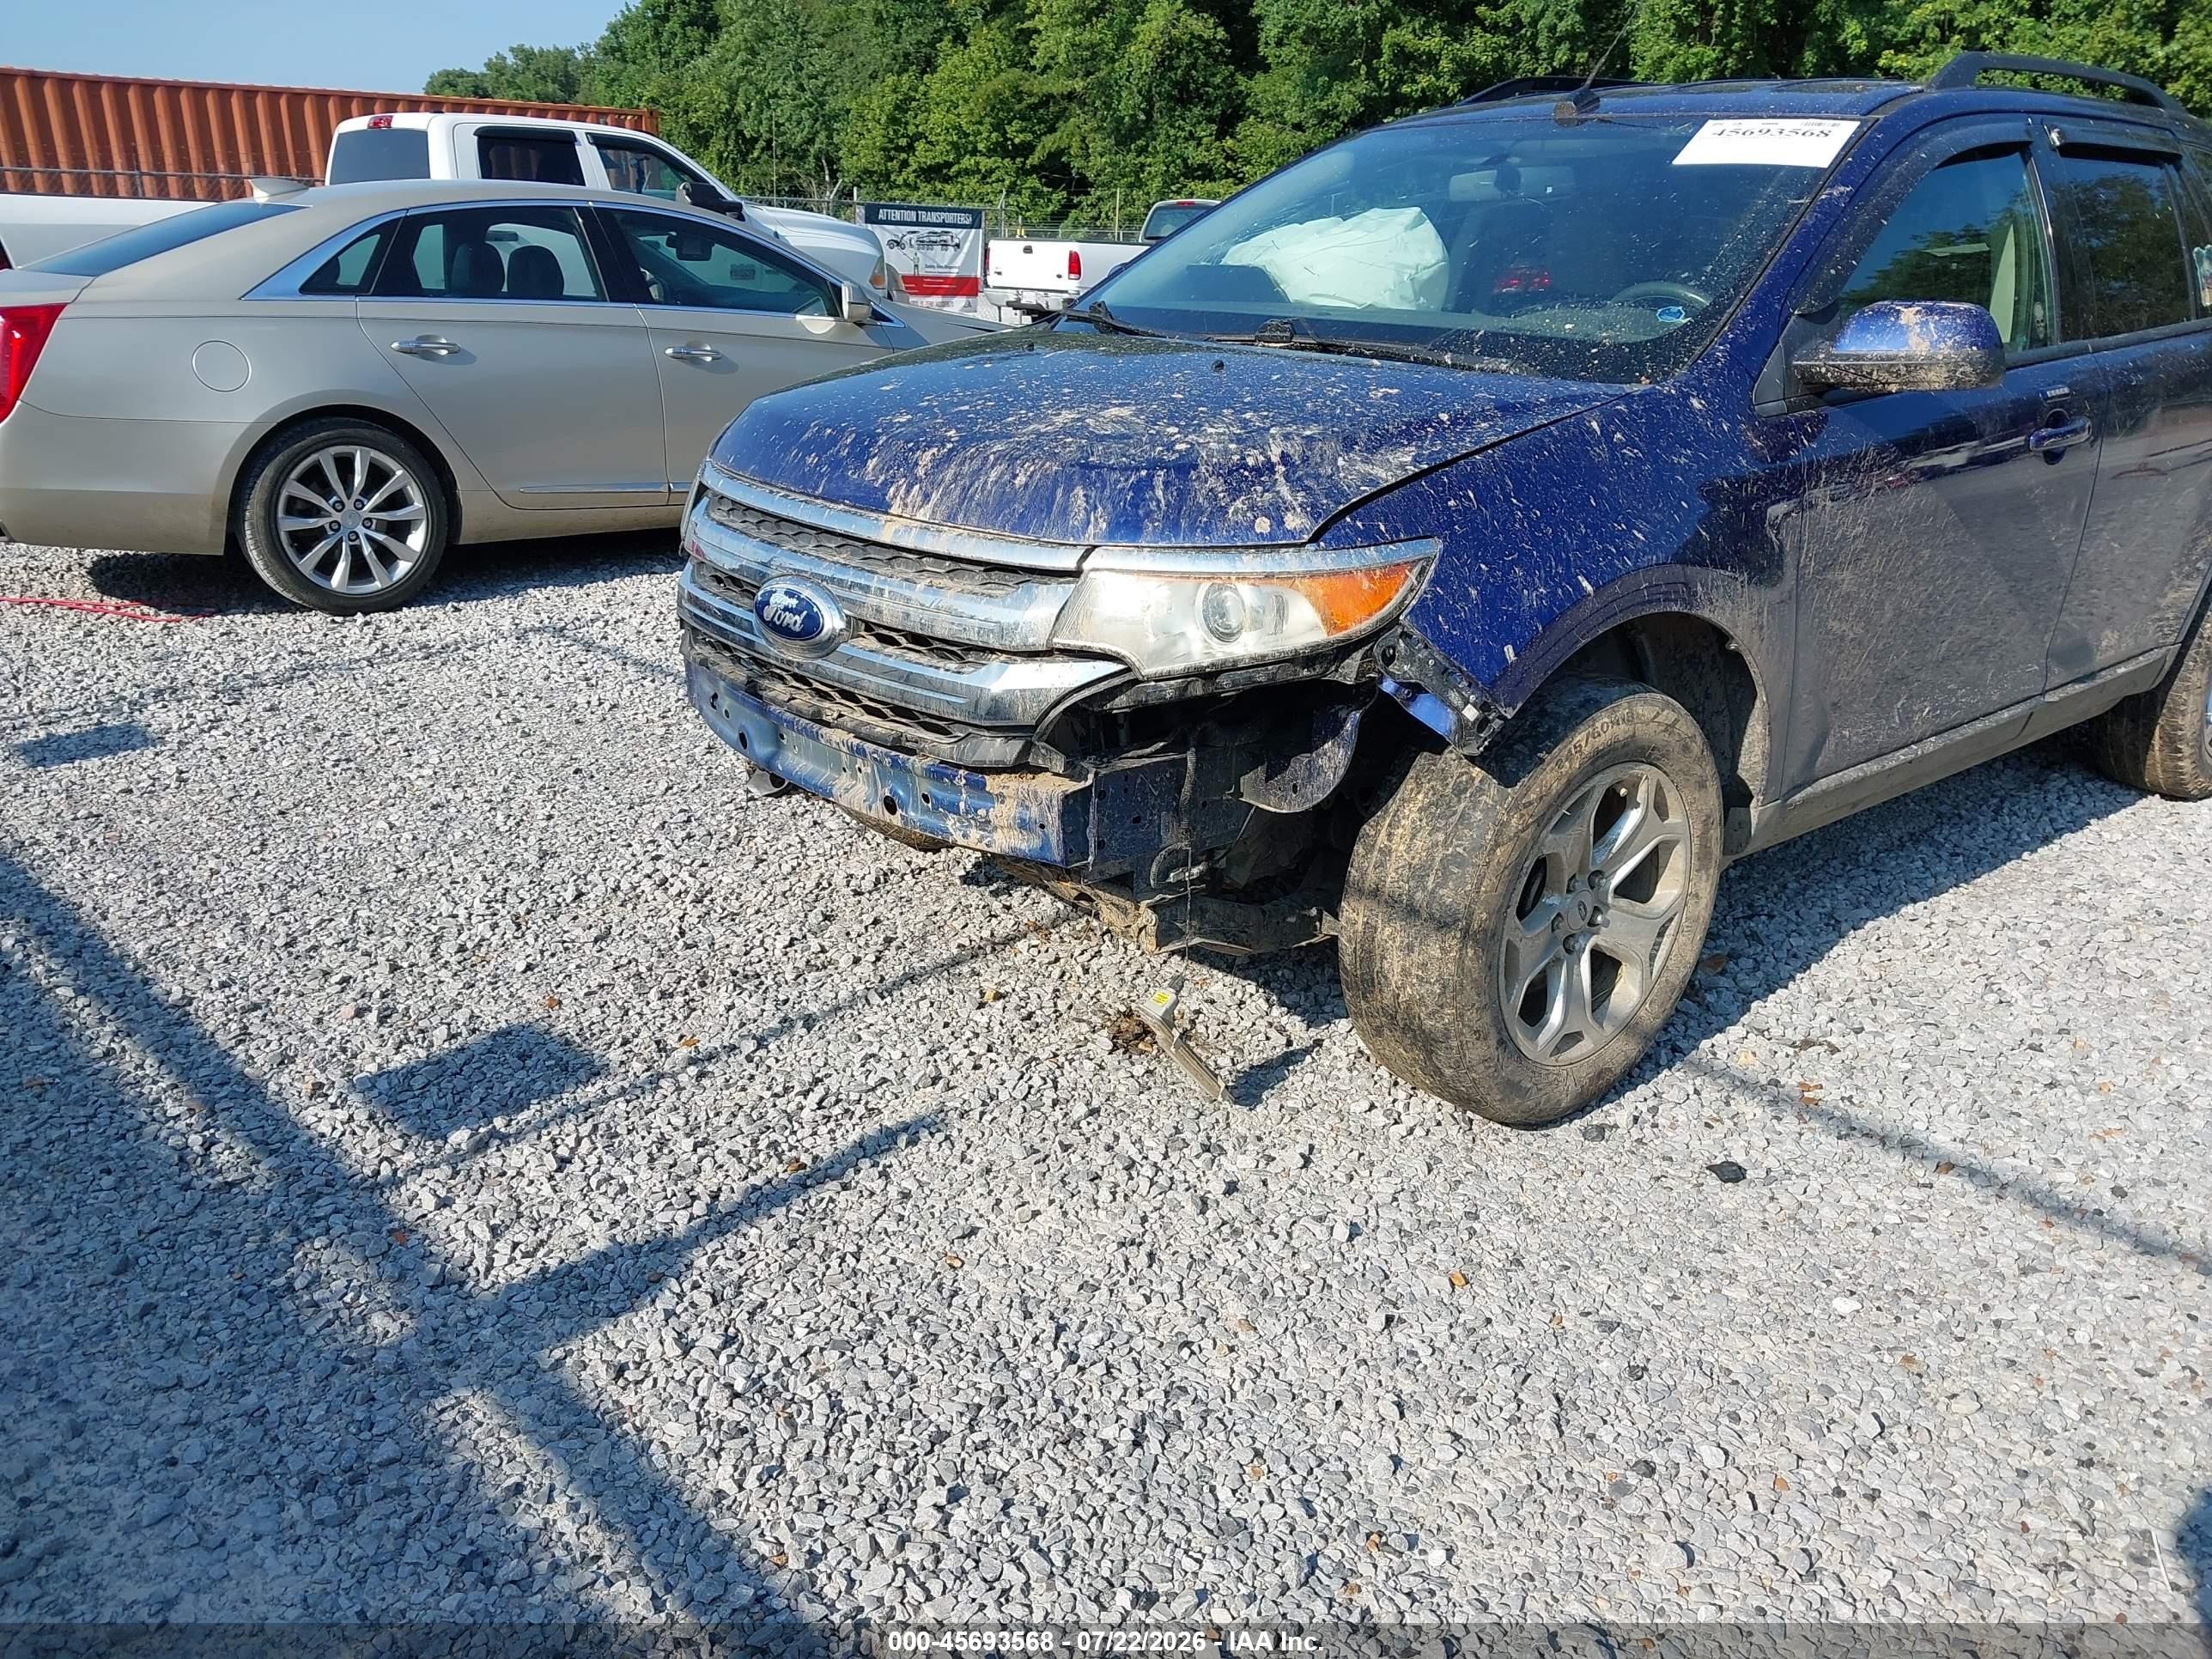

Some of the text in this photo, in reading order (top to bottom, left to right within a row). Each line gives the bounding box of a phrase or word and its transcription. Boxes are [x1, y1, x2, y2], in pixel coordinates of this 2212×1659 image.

[1711, 128, 1832, 137] 45693568
[878, 209, 916, 222] ATTENTION
[763, 592, 808, 633] Ford
